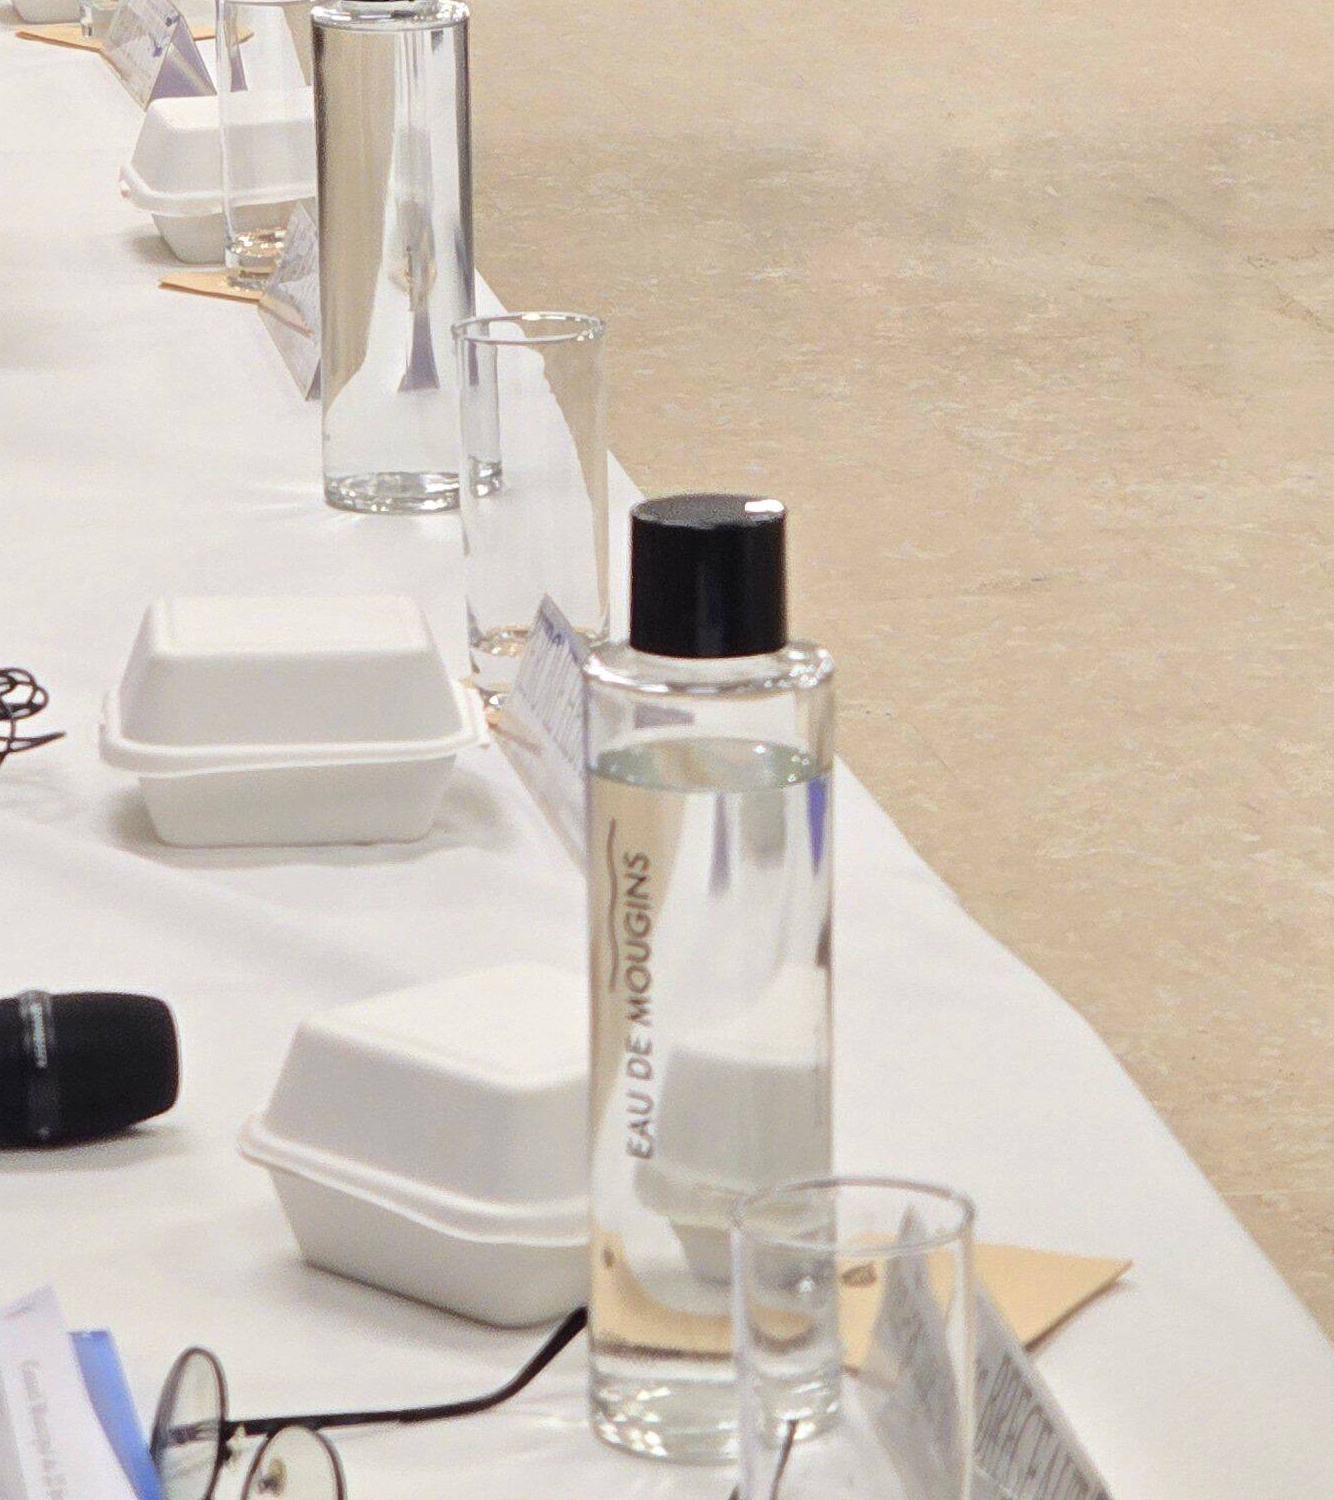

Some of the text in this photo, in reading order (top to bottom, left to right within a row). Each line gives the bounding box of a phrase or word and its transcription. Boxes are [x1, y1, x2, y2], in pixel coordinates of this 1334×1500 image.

[623, 852, 654, 1160] EAU DE MOUGINS
